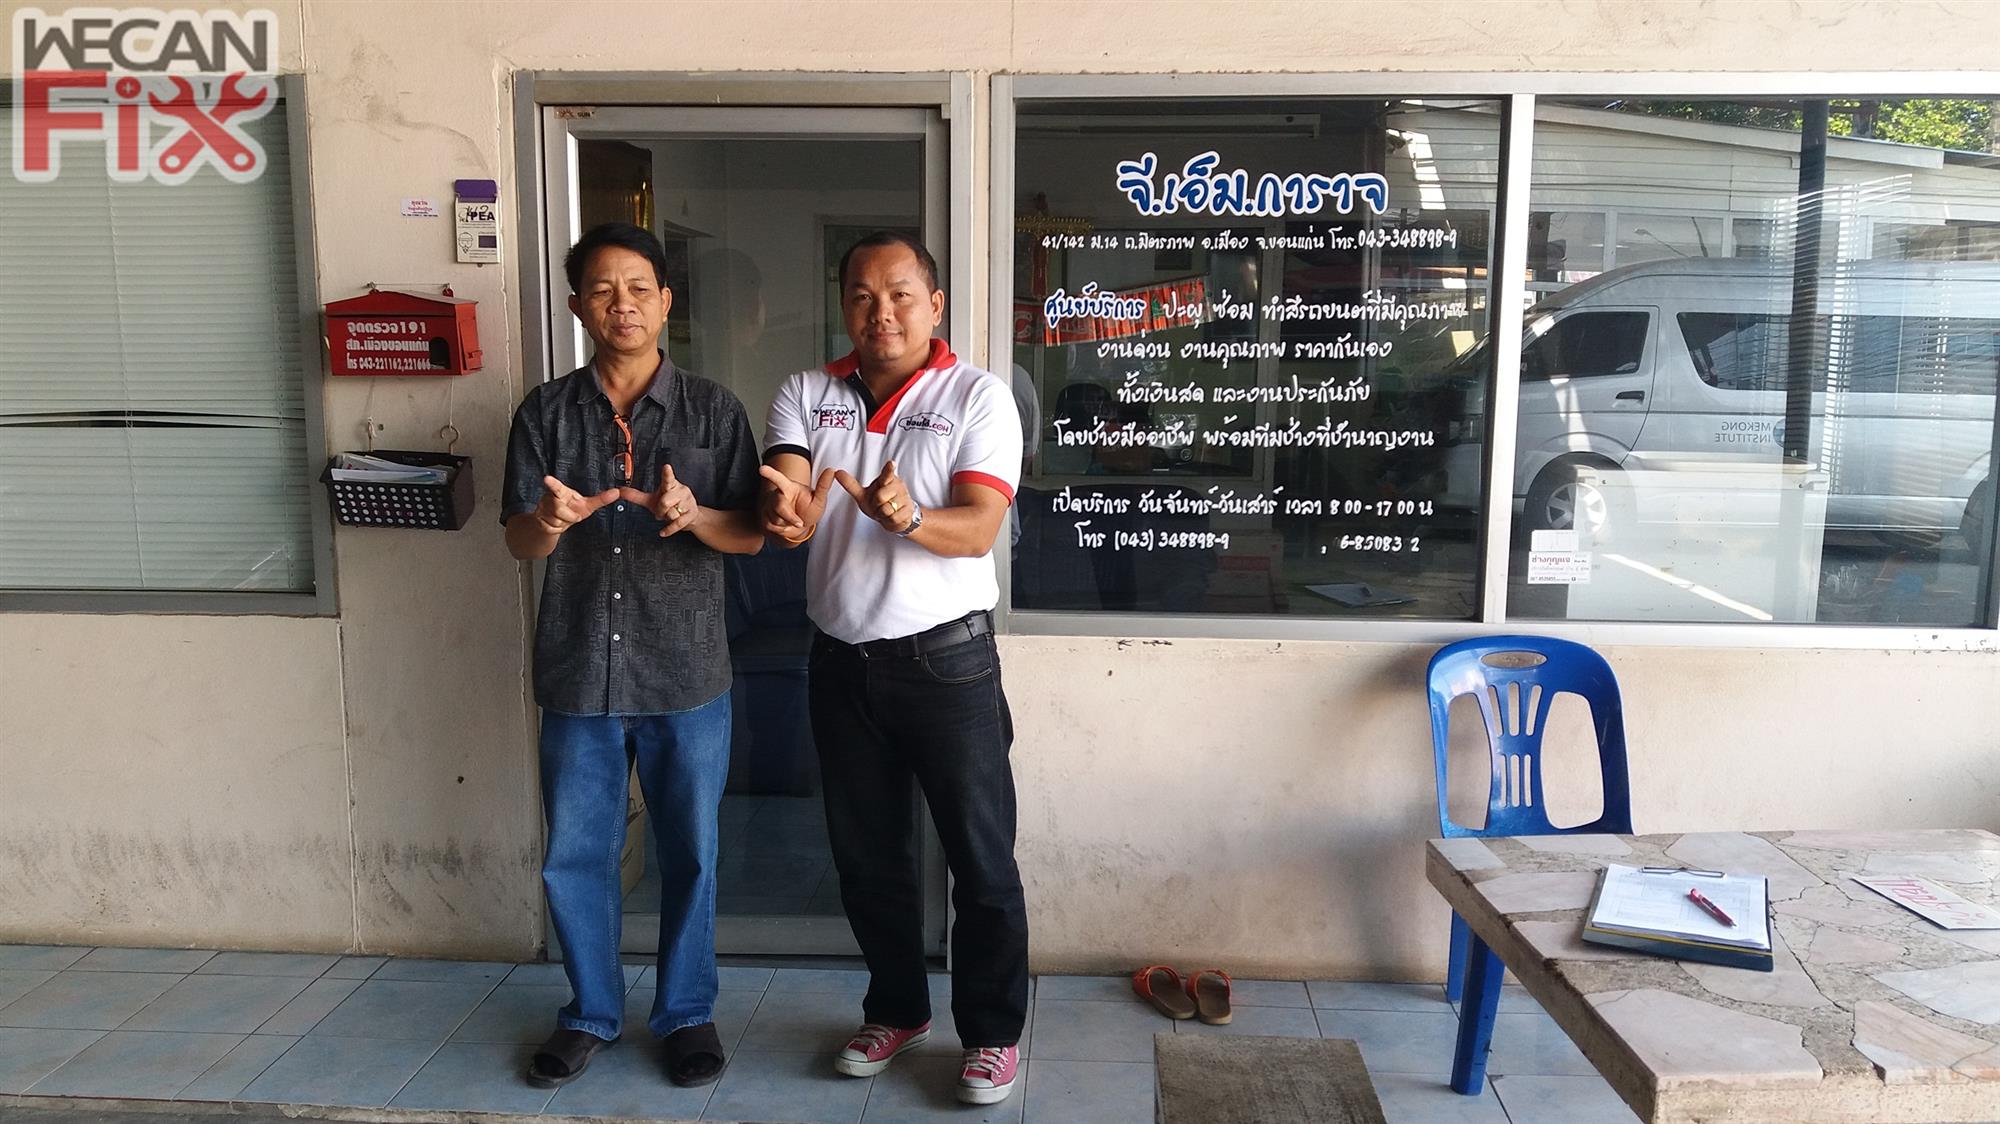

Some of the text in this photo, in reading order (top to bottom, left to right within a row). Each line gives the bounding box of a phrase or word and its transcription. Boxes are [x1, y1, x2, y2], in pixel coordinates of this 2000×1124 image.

[1116, 150, 1389, 217] จี.เอ็ม.การาจ
[470, 211, 496, 221] PEA
[1041, 233, 1085, 250] 41/142
[1090, 234, 1119, 250] ม.14
[1124, 230, 1195, 250] ถ.มิตรภาพ
[1201, 229, 1249, 250] อ.เมือง
[1256, 225, 1325, 250] จ.ขอนแก่น
[1044, 281, 1147, 329] ศูนย์บริการ
[1162, 290, 1204, 329] ปะผุ
[1213, 291, 1254, 320] ซ่อม
[1095, 328, 1393, 369] งานด่วน งานคุณภาพ ราคากันเอง
[1116, 371, 1370, 404] ทั้งเงินสด และงานประกันภัย
[1053, 415, 1435, 450] โดยช่างมืออาชีพ พร้อมทีมช่างที่ชำนาญงาน
[1052, 490, 1131, 515] เปิดบริการ
[1138, 486, 1282, 515] วันจันทร์-วันเสาร์
[1285, 499, 1322, 516] เวลา
[1074, 520, 1106, 549] โทร
[1158, 531, 1230, 550] 348898-9
